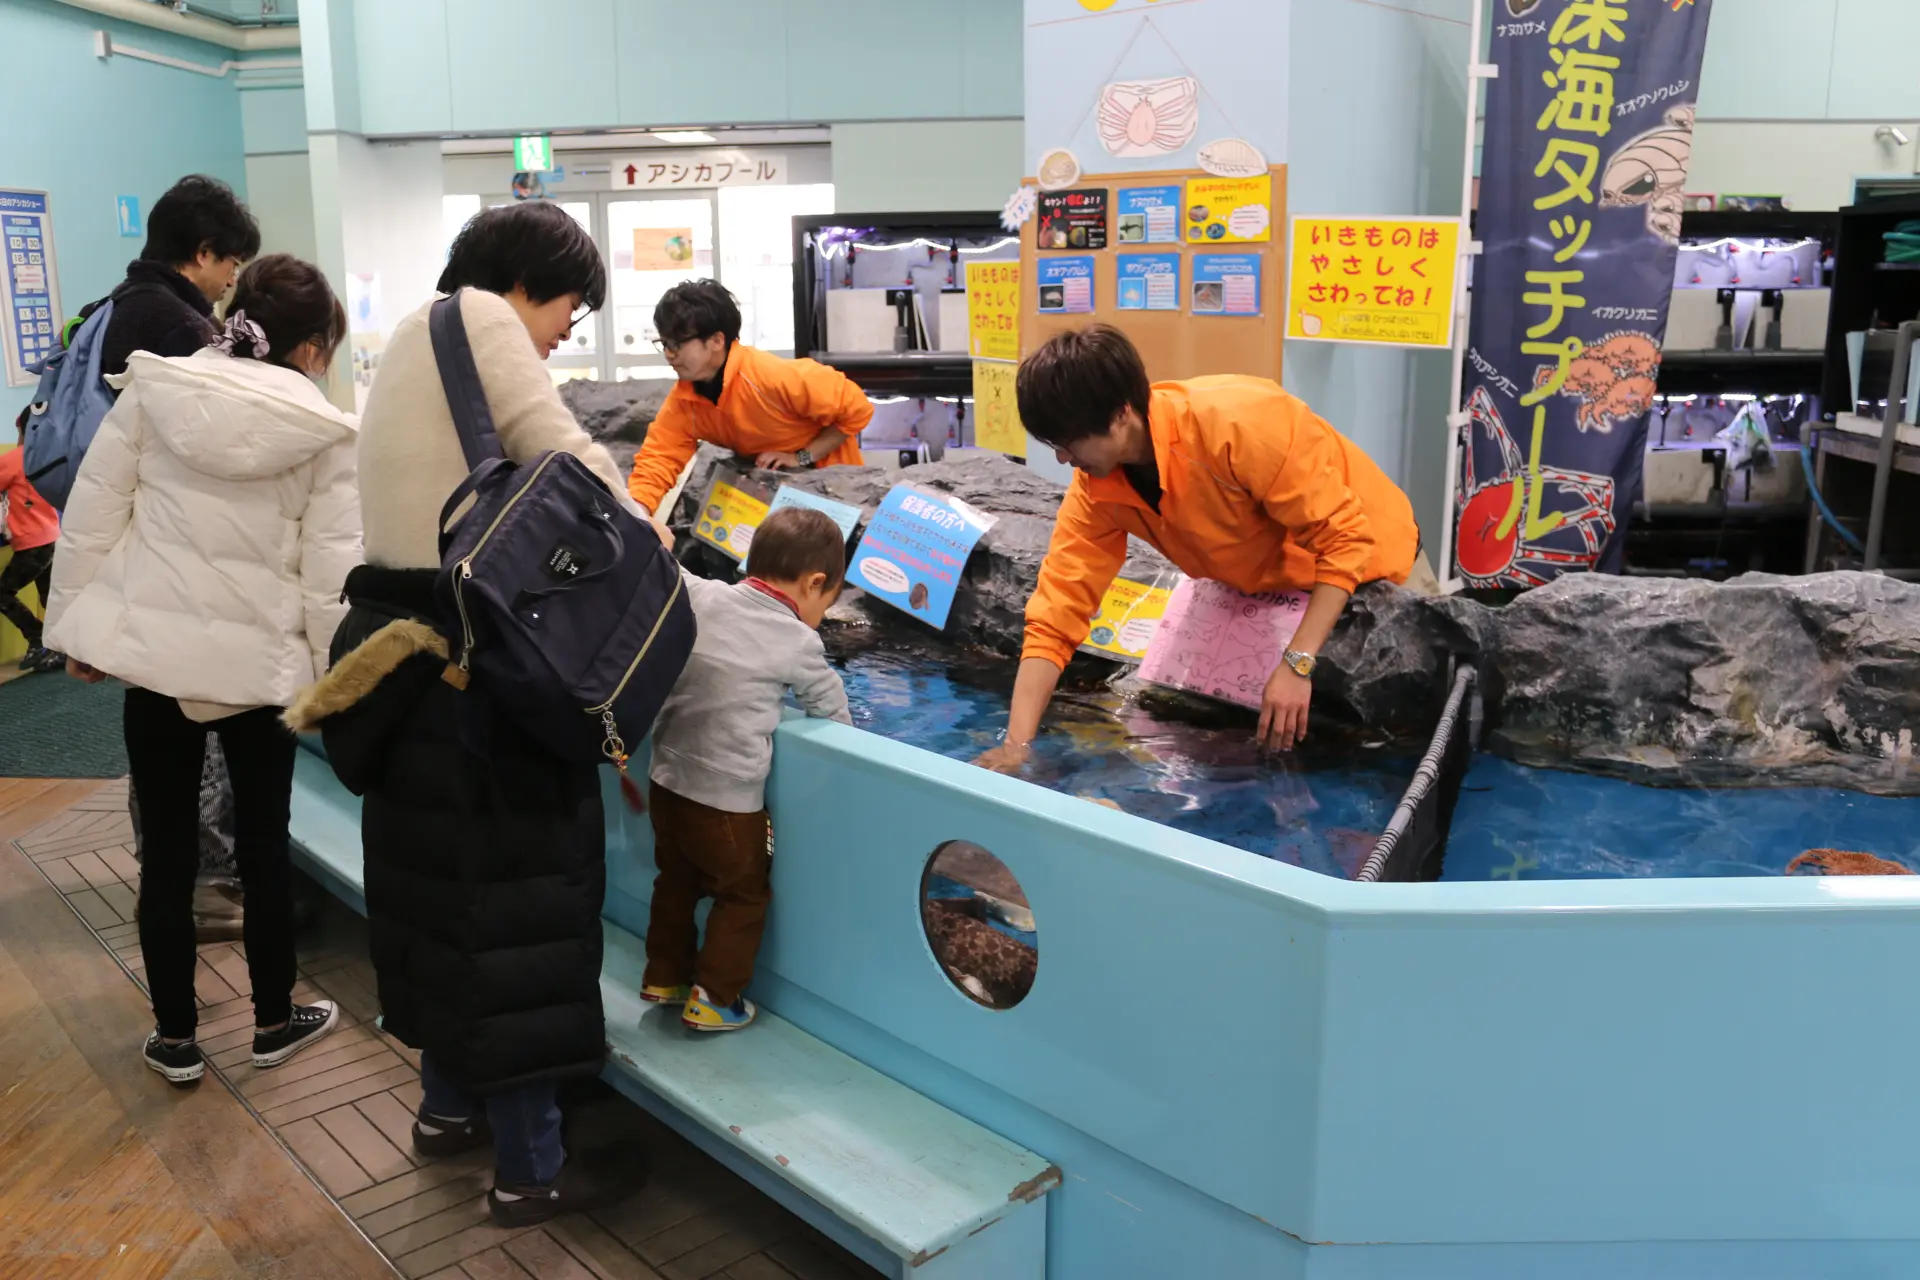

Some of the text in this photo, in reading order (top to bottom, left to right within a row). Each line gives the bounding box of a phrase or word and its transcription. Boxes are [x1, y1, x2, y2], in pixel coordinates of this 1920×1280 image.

[1311, 225, 1440, 249] いきものは
[972, 267, 1020, 284] いきものは
[1310, 253, 1428, 278] やさしく
